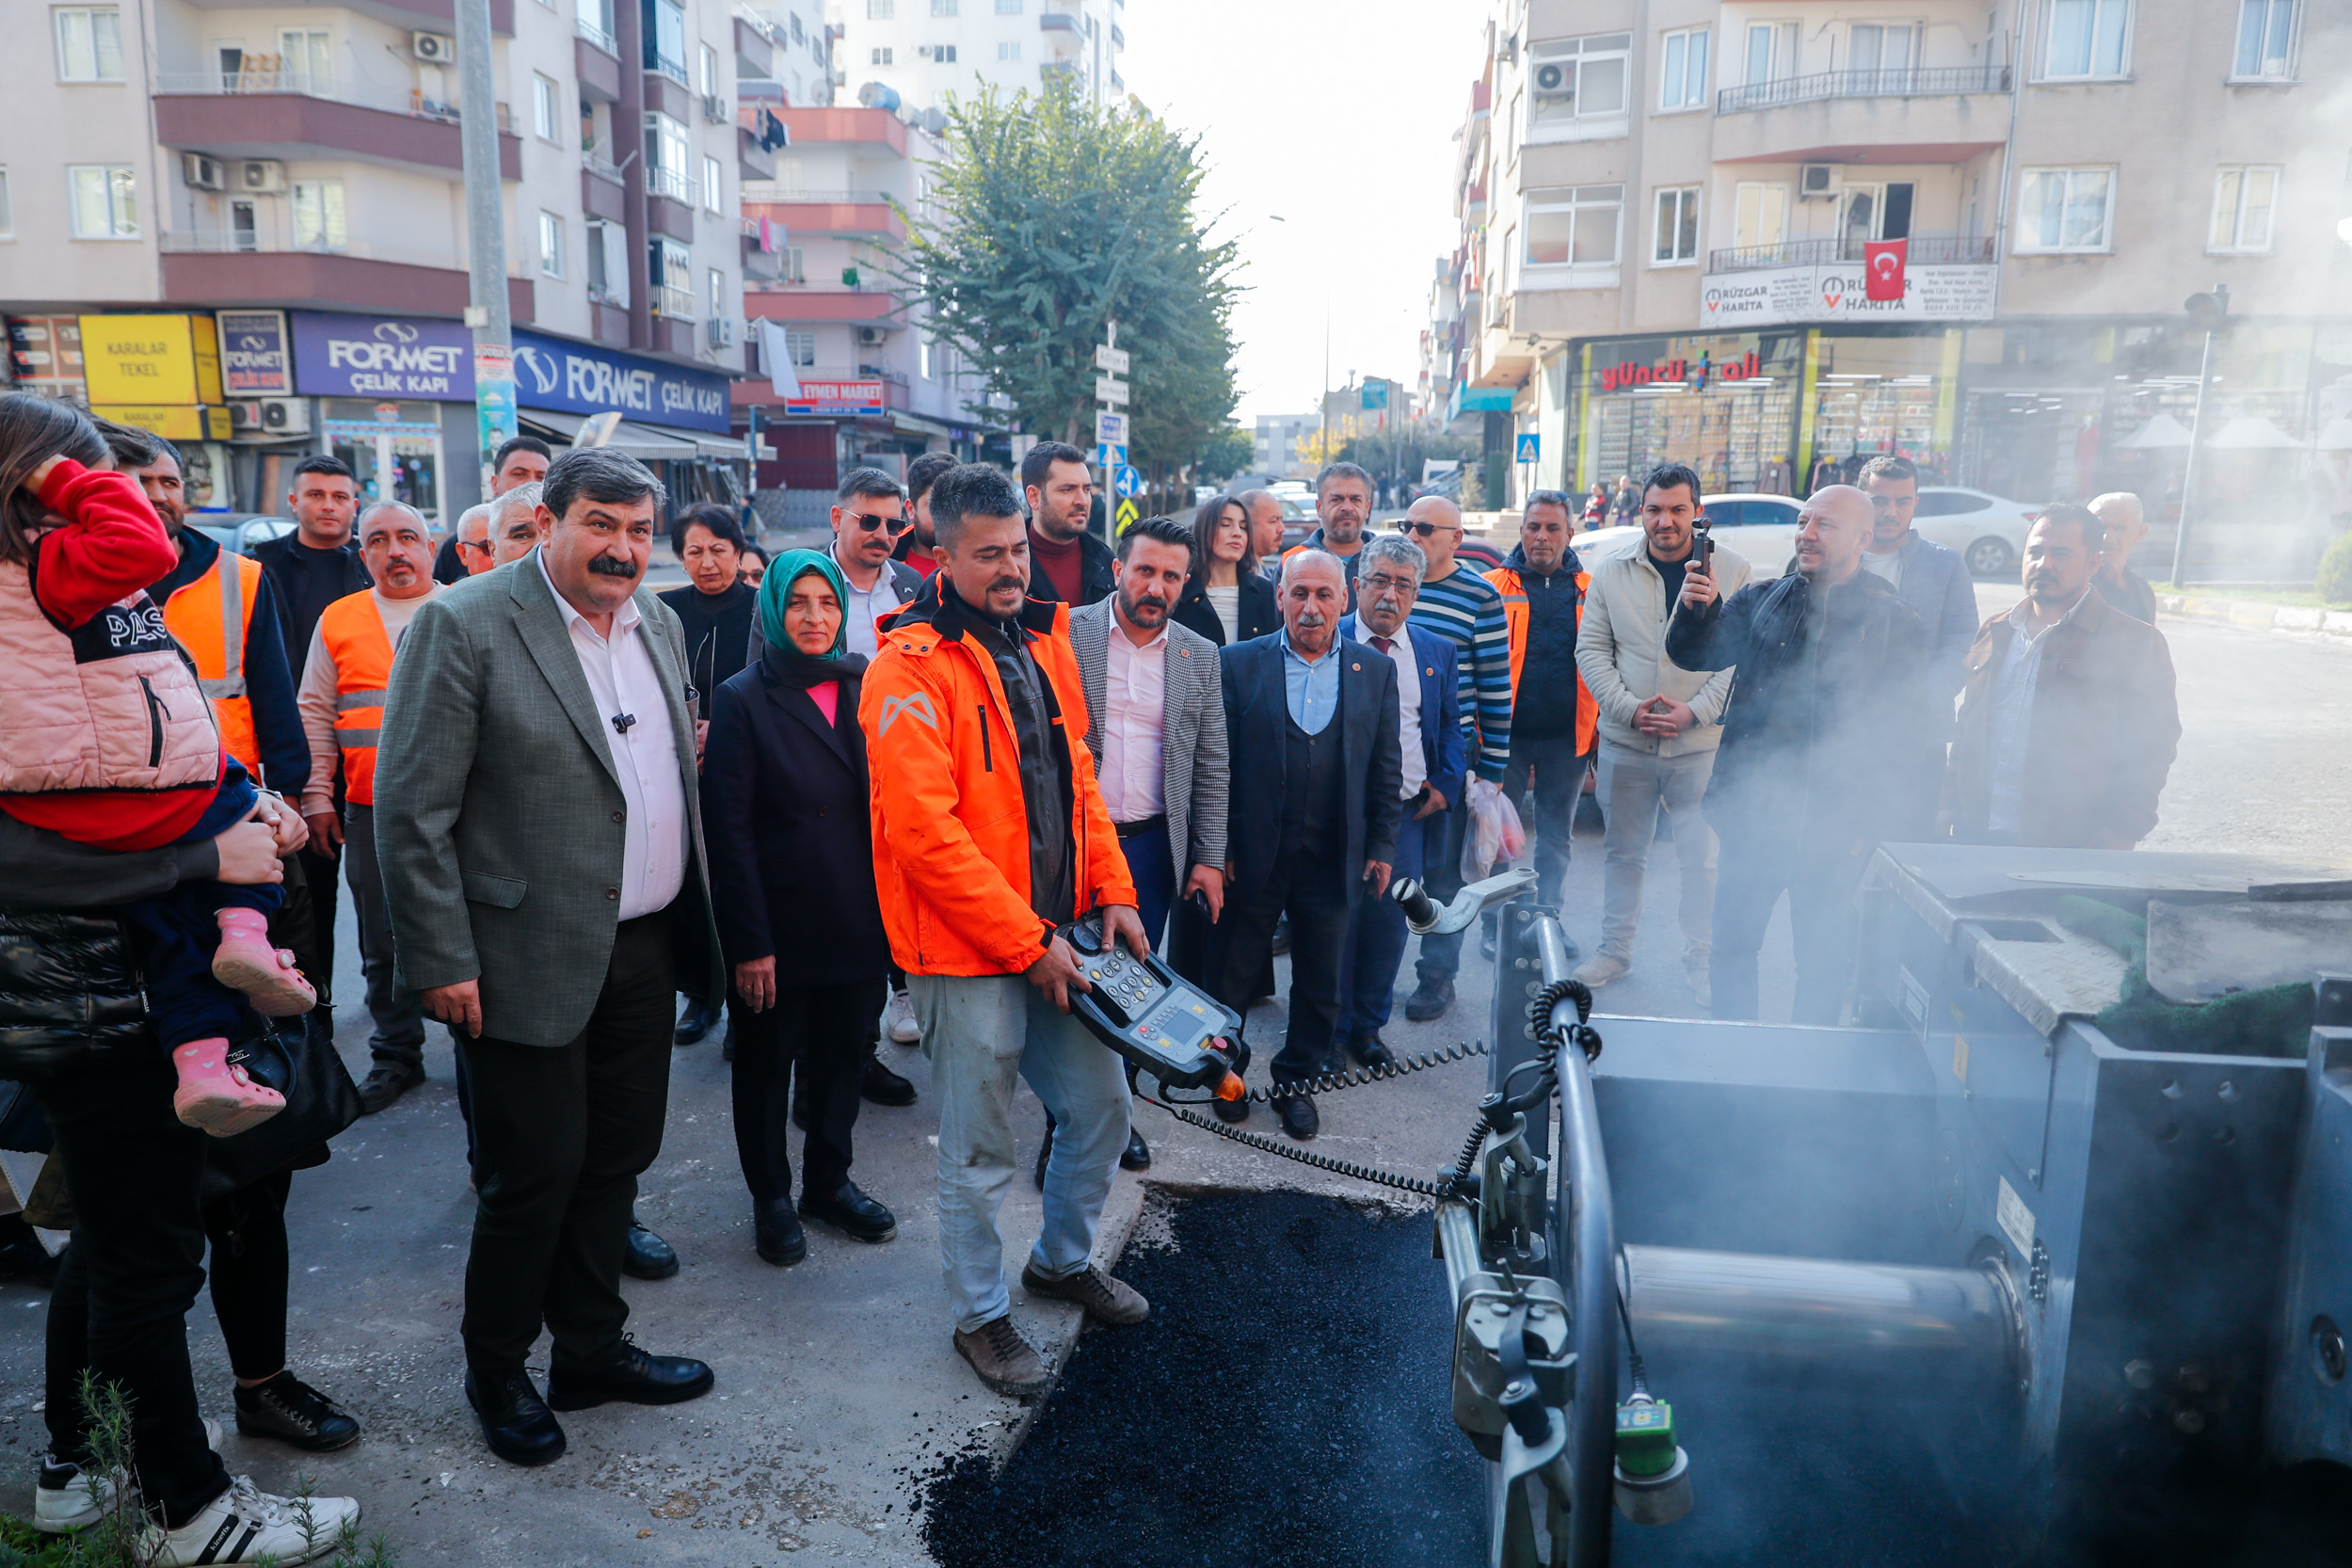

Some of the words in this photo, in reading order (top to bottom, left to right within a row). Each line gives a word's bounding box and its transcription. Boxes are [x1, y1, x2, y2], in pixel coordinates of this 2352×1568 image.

[1722, 286, 1768, 298] RÜZGAR
[1847, 276, 1912, 292] RÜR
[1721, 300, 1763, 312] HARİTA
[106, 342, 168, 356] KARALAR
[328, 340, 464, 374] FORMET
[226, 350, 282, 368] FORMET
[119, 362, 159, 377] TEKEL
[229, 368, 258, 388] ÇELİK
[261, 372, 285, 387] KAPI
[1602, 359, 1684, 392] yüncü
[1721, 351, 1760, 380] ali
[349, 372, 403, 393] ÇELİK
[407, 376, 449, 393] KAPI
[566, 354, 655, 411] FORMET
[661, 379, 696, 414] ÇELİK
[697, 388, 723, 416] KAPI
[804, 383, 839, 399] EYMEN
[840, 384, 881, 400] MARKET
[105, 607, 168, 647] PAS
